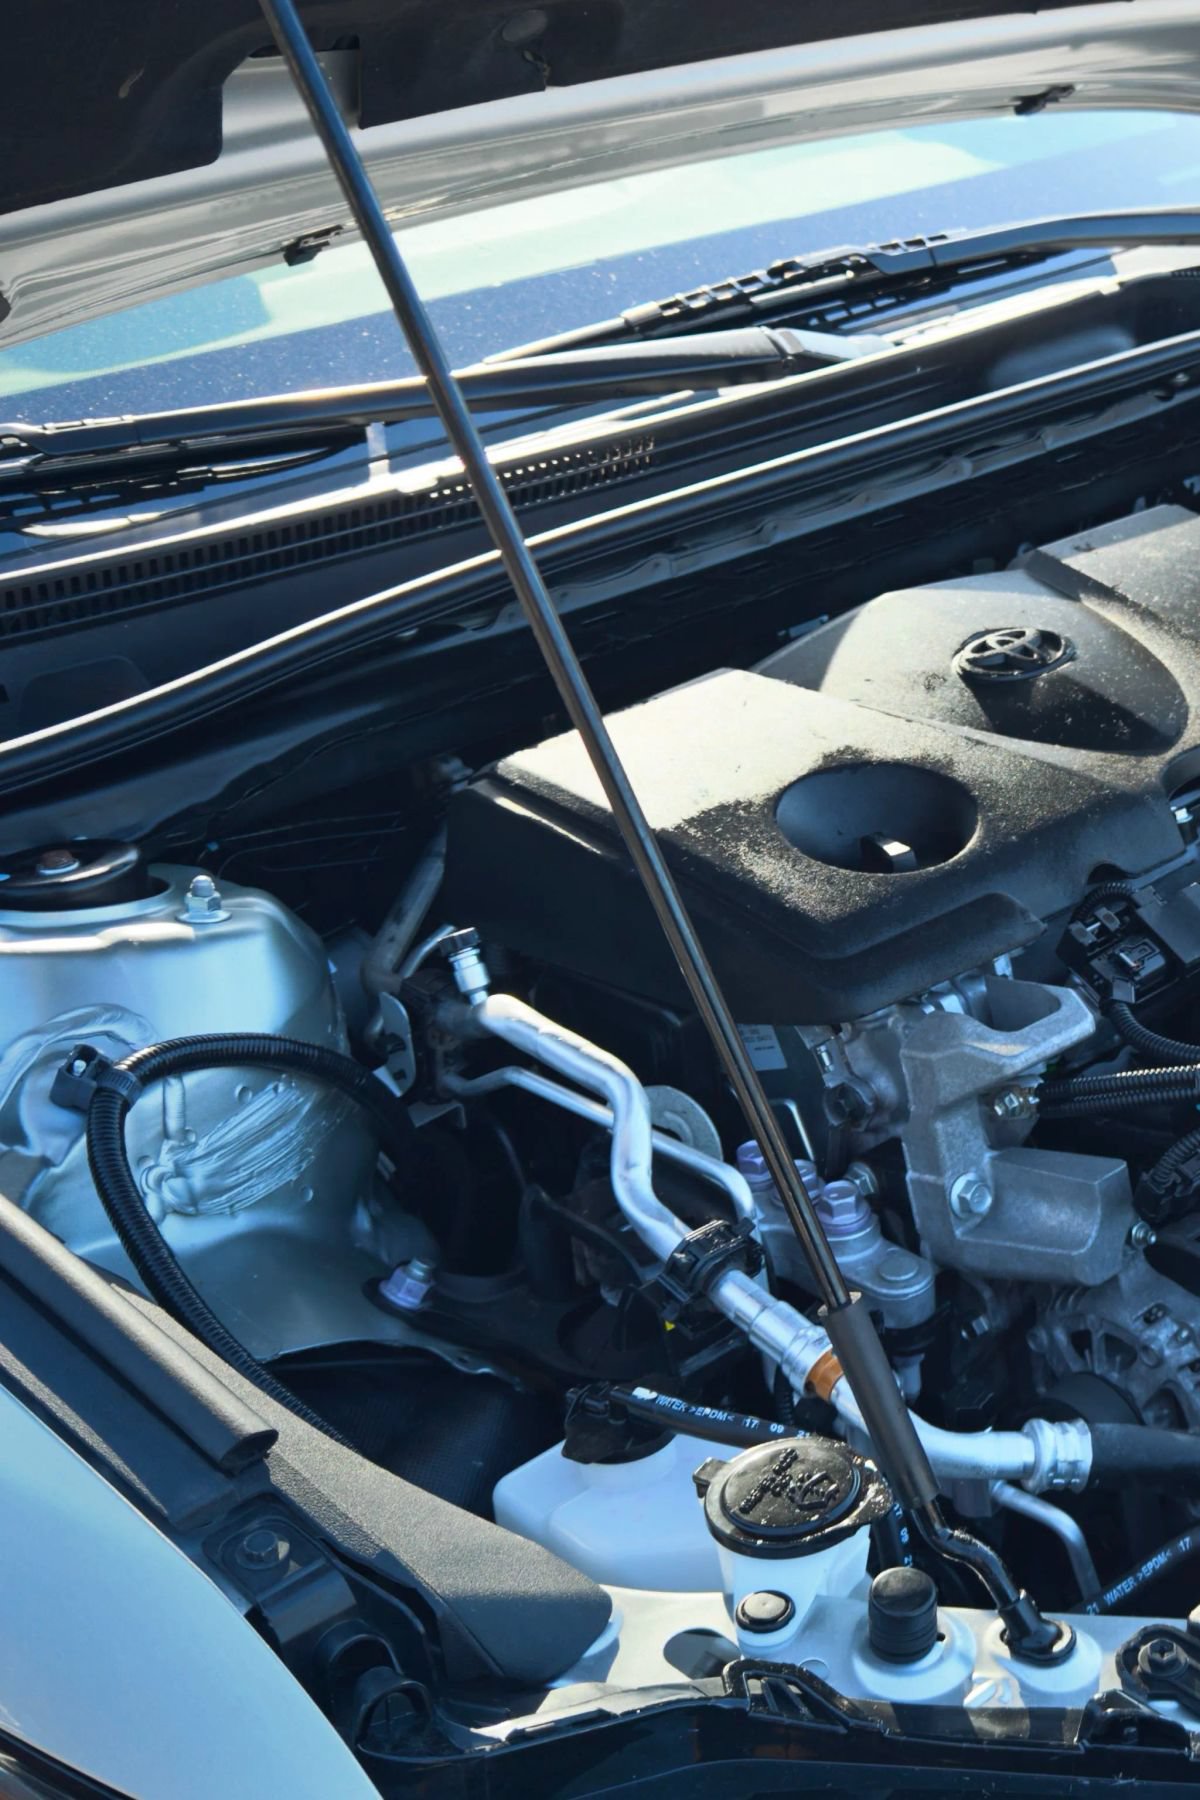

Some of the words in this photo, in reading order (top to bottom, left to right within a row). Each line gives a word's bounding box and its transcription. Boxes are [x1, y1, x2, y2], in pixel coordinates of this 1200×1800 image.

[744, 1418, 759, 1429] 17
[770, 1423, 785, 1433] 09
[1103, 1576, 1137, 1606] WATER
[1179, 1536, 1191, 1552] 17
